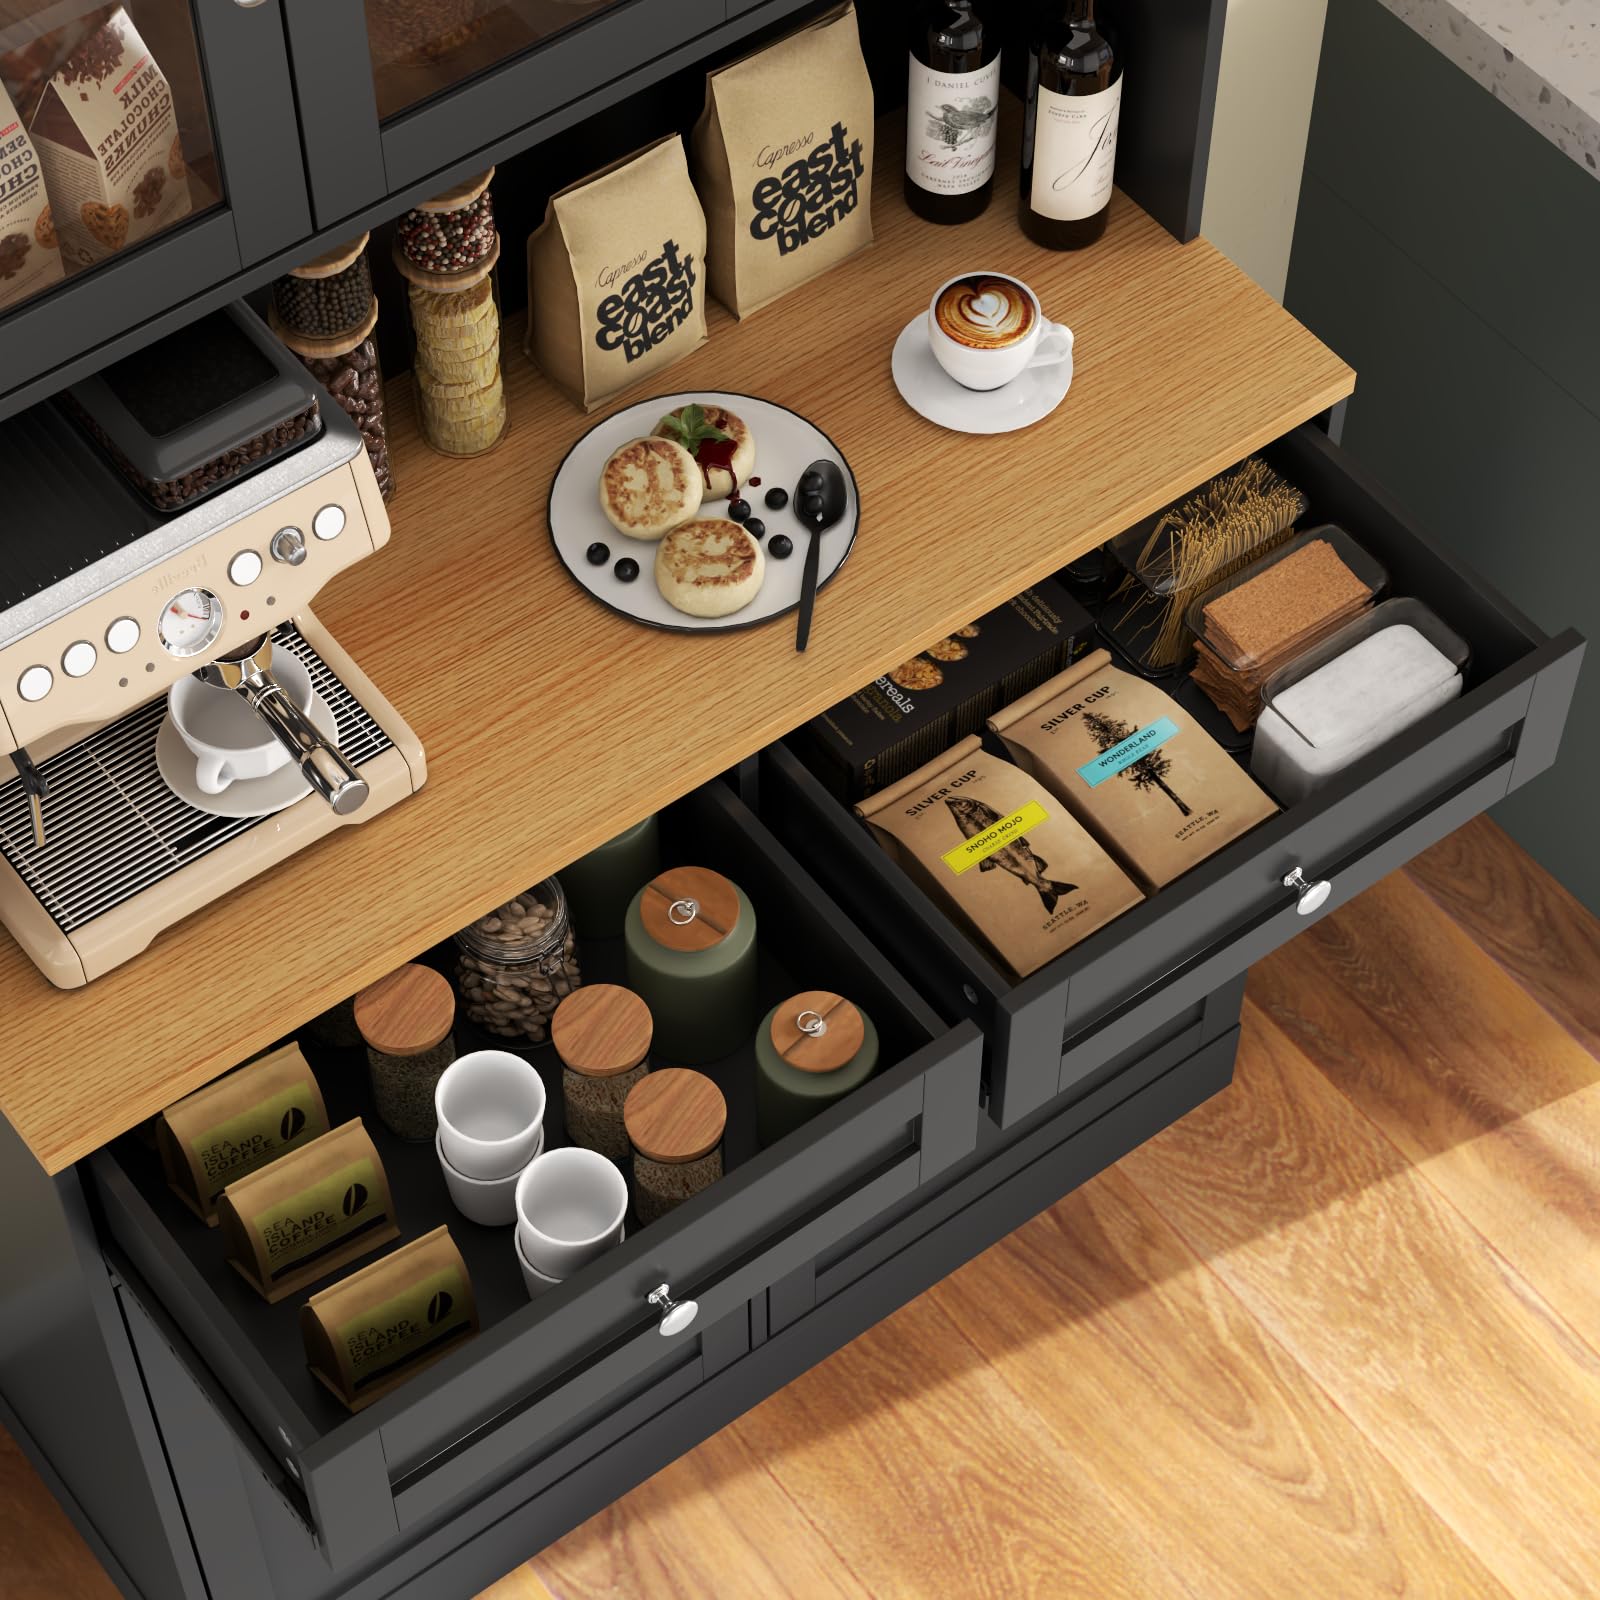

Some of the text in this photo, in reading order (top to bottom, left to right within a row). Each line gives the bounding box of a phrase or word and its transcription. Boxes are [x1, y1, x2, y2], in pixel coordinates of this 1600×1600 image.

[934, 79, 970, 89] DANIEL
[752, 121, 848, 211] east
[750, 139, 864, 240] coast
[777, 178, 858, 256] blend
[597, 239, 684, 325] east
[596, 253, 696, 351] coast
[623, 287, 693, 363] blend
[875, 676, 914, 713] ereals
[1040, 685, 1111, 733] SILVER CUP
[1098, 729, 1156, 768] WONDERLAND
[905, 787, 951, 817] SILVER
[950, 769, 978, 789] CUP
[966, 830, 998, 854] SNOHO
[998, 815, 1023, 834] MOJO
[201, 1140, 233, 1161] SEA
[204, 1134, 263, 1169] ISLAND
[207, 1138, 273, 1177] COFFEE
[263, 1217, 295, 1236] SEA
[266, 1211, 326, 1246] ISLAND
[269, 1215, 336, 1253] COFFEE
